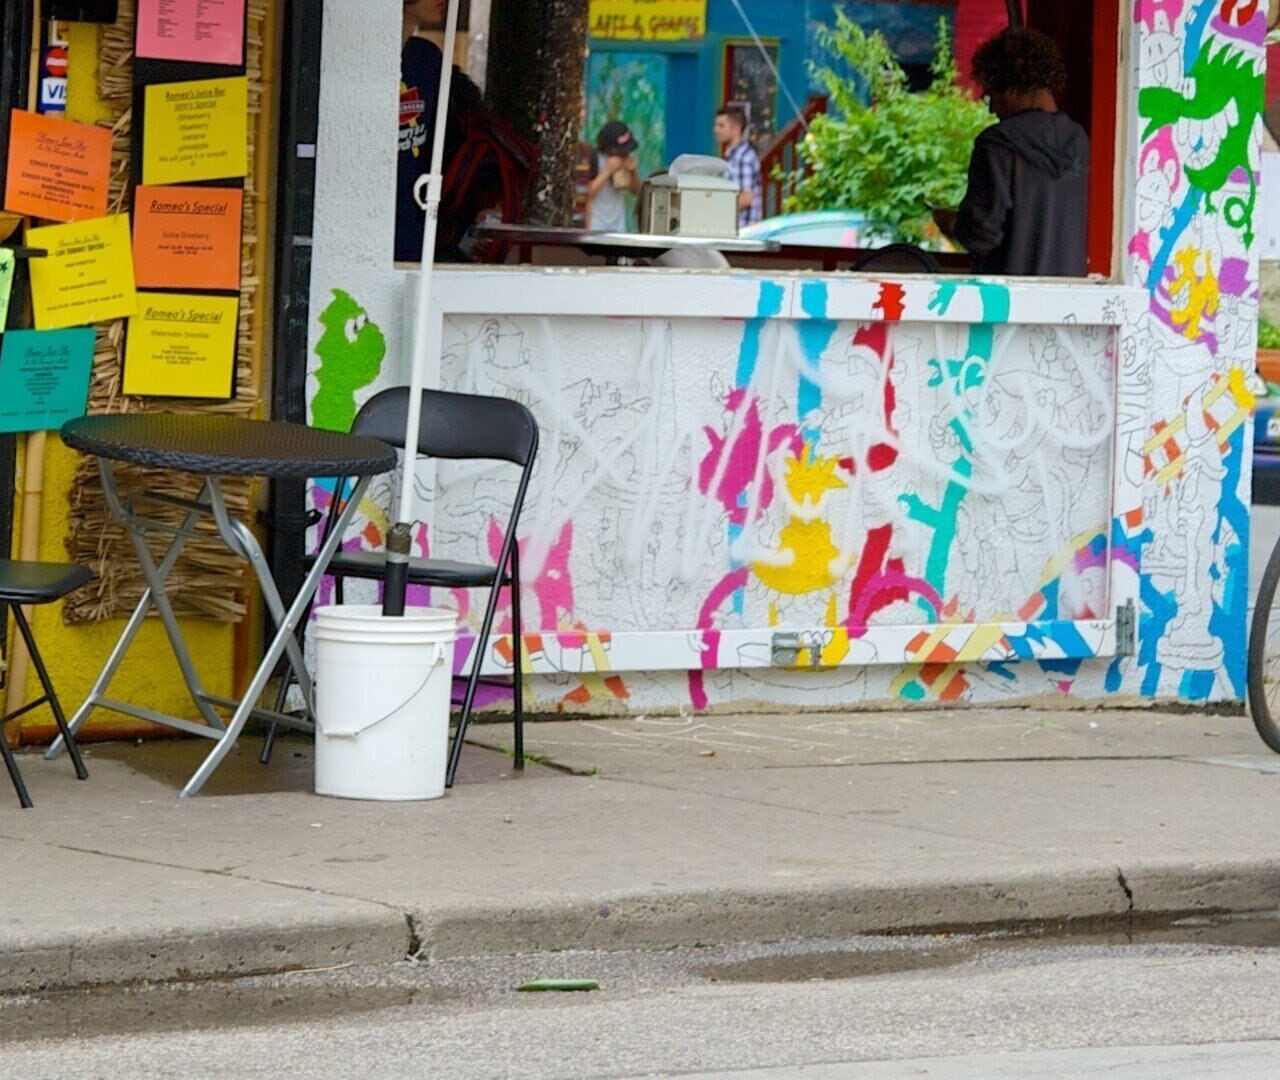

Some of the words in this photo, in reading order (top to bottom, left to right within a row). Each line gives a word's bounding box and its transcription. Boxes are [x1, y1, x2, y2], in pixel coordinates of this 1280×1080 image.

[149, 199, 190, 213] Romeo's
[192, 201, 228, 215] Special
[144, 307, 186, 321] Romeo's
[187, 309, 223, 324] Special
